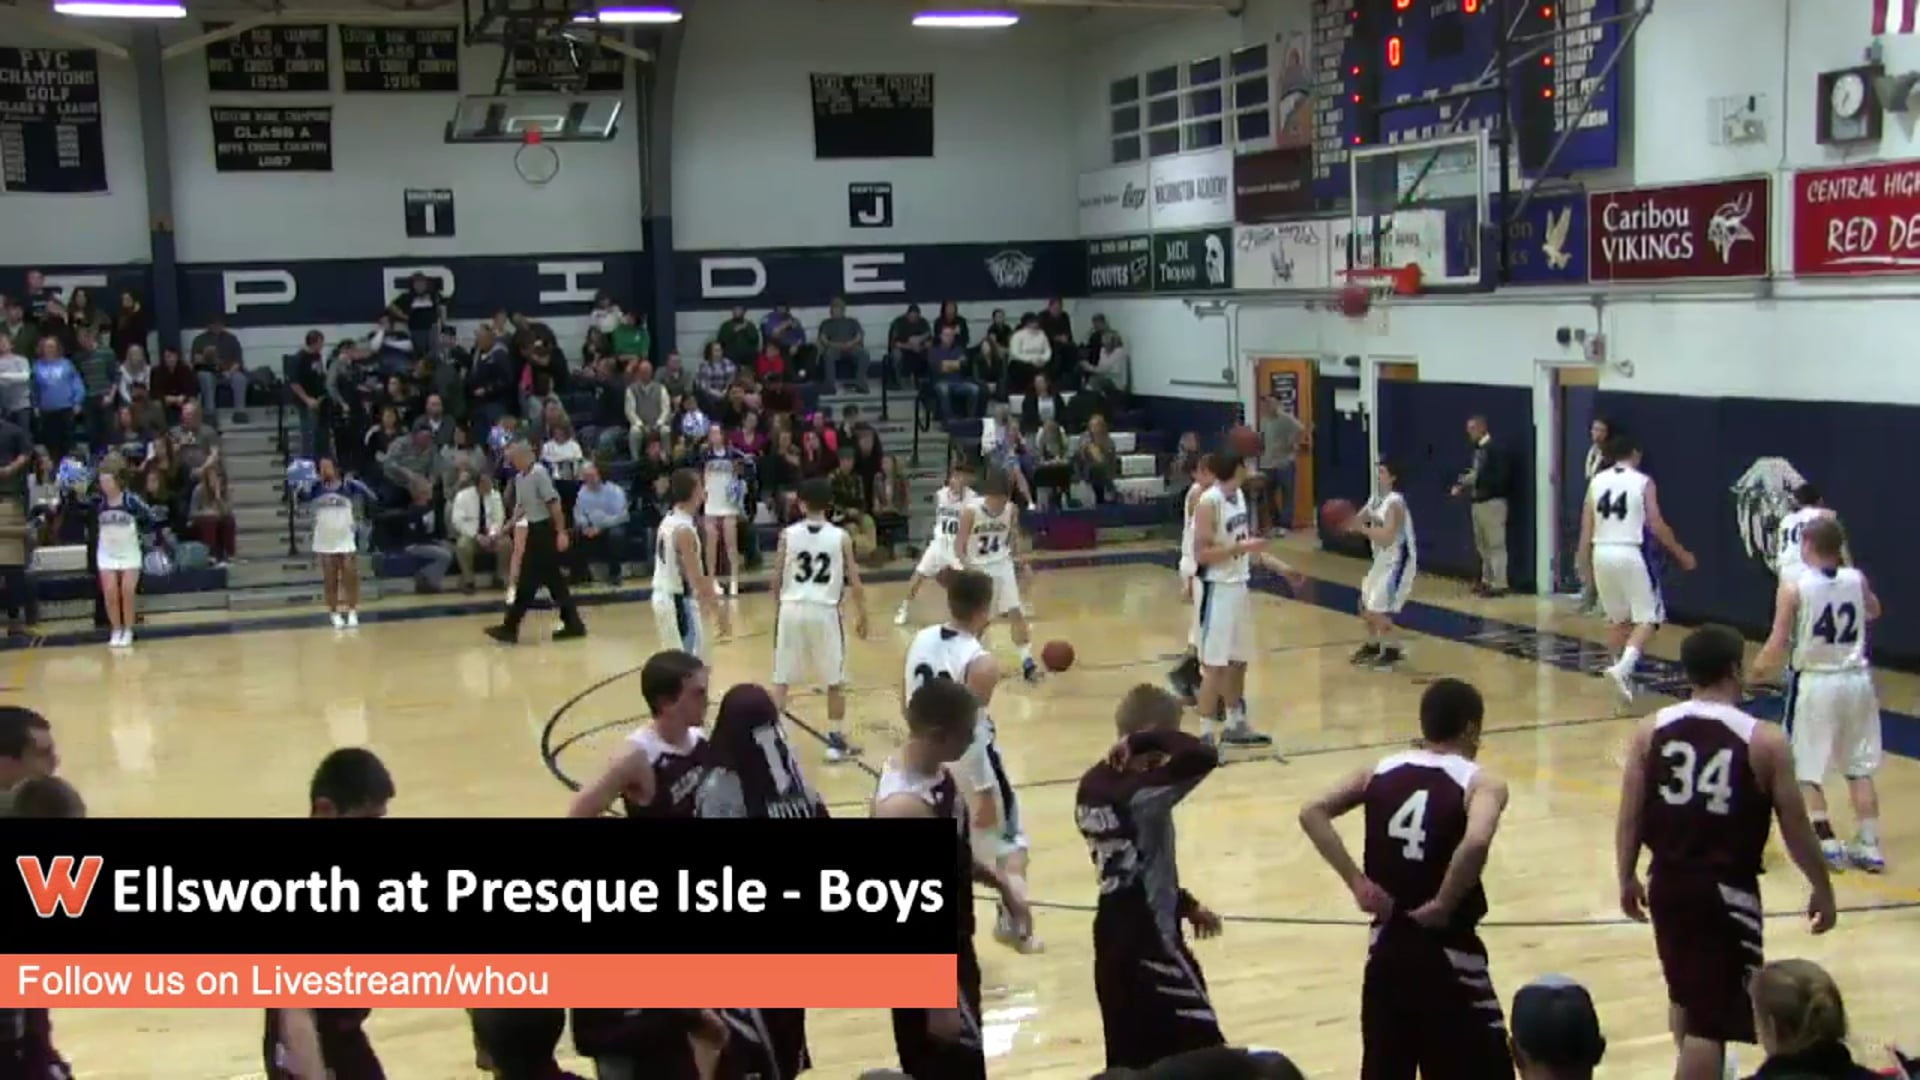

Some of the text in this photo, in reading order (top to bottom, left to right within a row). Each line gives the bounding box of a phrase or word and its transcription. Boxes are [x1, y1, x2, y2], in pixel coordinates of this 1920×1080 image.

[21, 49, 70, 70] PVC
[1388, 36, 1401, 67] 0
[0, 69, 95, 86] CHAMPIONS
[26, 85, 70, 101] GOLF
[300, 126, 311, 139] A
[1807, 173, 1877, 202] CENTRAL
[858, 196, 885, 224] J
[1603, 199, 1690, 232] Caribou
[1602, 232, 1694, 262] VIKINGS
[1827, 216, 1878, 253] RED
[1597, 488, 1628, 520] 44
[795, 550, 831, 584] 32
[1812, 601, 1858, 644] 42
[1658, 739, 1733, 815] 34
[1387, 789, 1429, 861] 4
